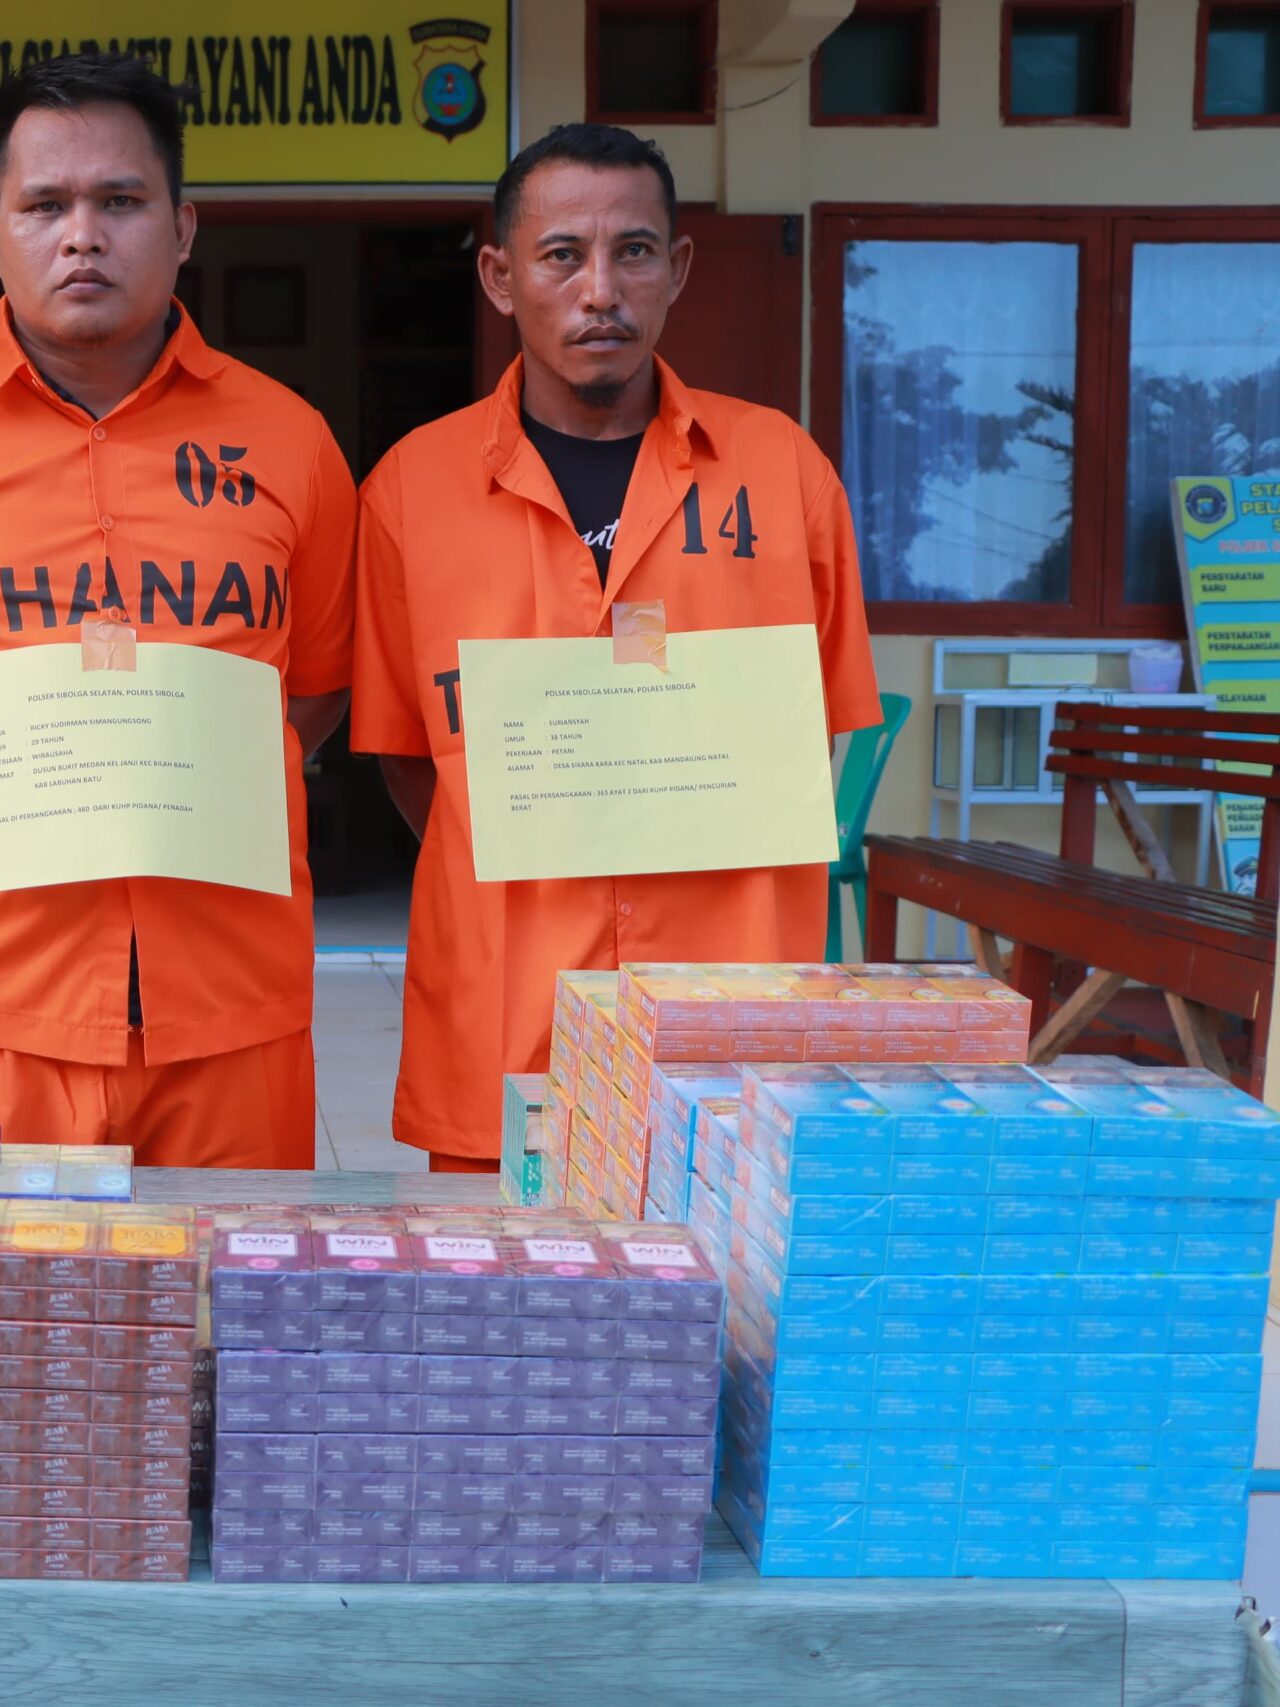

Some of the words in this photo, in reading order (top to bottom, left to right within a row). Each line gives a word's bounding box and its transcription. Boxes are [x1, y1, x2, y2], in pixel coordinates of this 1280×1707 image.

[299, 35, 402, 125] ANDA
[175, 441, 256, 508] 05
[681, 482, 758, 559] 14
[27, 693, 55, 703] POLSEK
[56, 690, 88, 699] SIBOLGA
[126, 689, 154, 697] POLRES
[155, 690, 186, 699] SIBOLGA
[544, 690, 571, 698] POLSEK
[637, 685, 664, 694] POLRES
[665, 683, 697, 692] SIBOLGA
[30, 723, 49, 732] RICKY
[50, 719, 88, 729] SUDIRMAN
[503, 721, 525, 729] NAMA
[31, 739, 40, 747] 29
[41, 736, 65, 745] TAHUN
[32, 749, 74, 760] WIRAUSAHA
[553, 762, 570, 770] DESA
[664, 755, 707, 764] MANDAILING
[708, 753, 730, 761] NATAL
[32, 766, 57, 775] DUSUN
[58, 763, 78, 772] BUKIT
[79, 761, 106, 769] MEDAN
[174, 762, 194, 770] BARAT
[34, 782, 48, 790] KAB
[49, 778, 82, 787] LABUHAN
[83, 776, 102, 784] BATU
[540, 791, 592, 799] PERSANGKAKAN
[632, 787, 649, 795] DARI
[650, 786, 668, 794] KUHP
[699, 782, 738, 790] PENCURIAN
[10, 815, 18, 823] DI
[19, 808, 73, 821] PERSANGKAKAN
[78, 806, 90, 814] 480
[92, 804, 110, 812] DARI
[163, 804, 194, 812] PENADAH
[511, 804, 532, 812] BERAT
